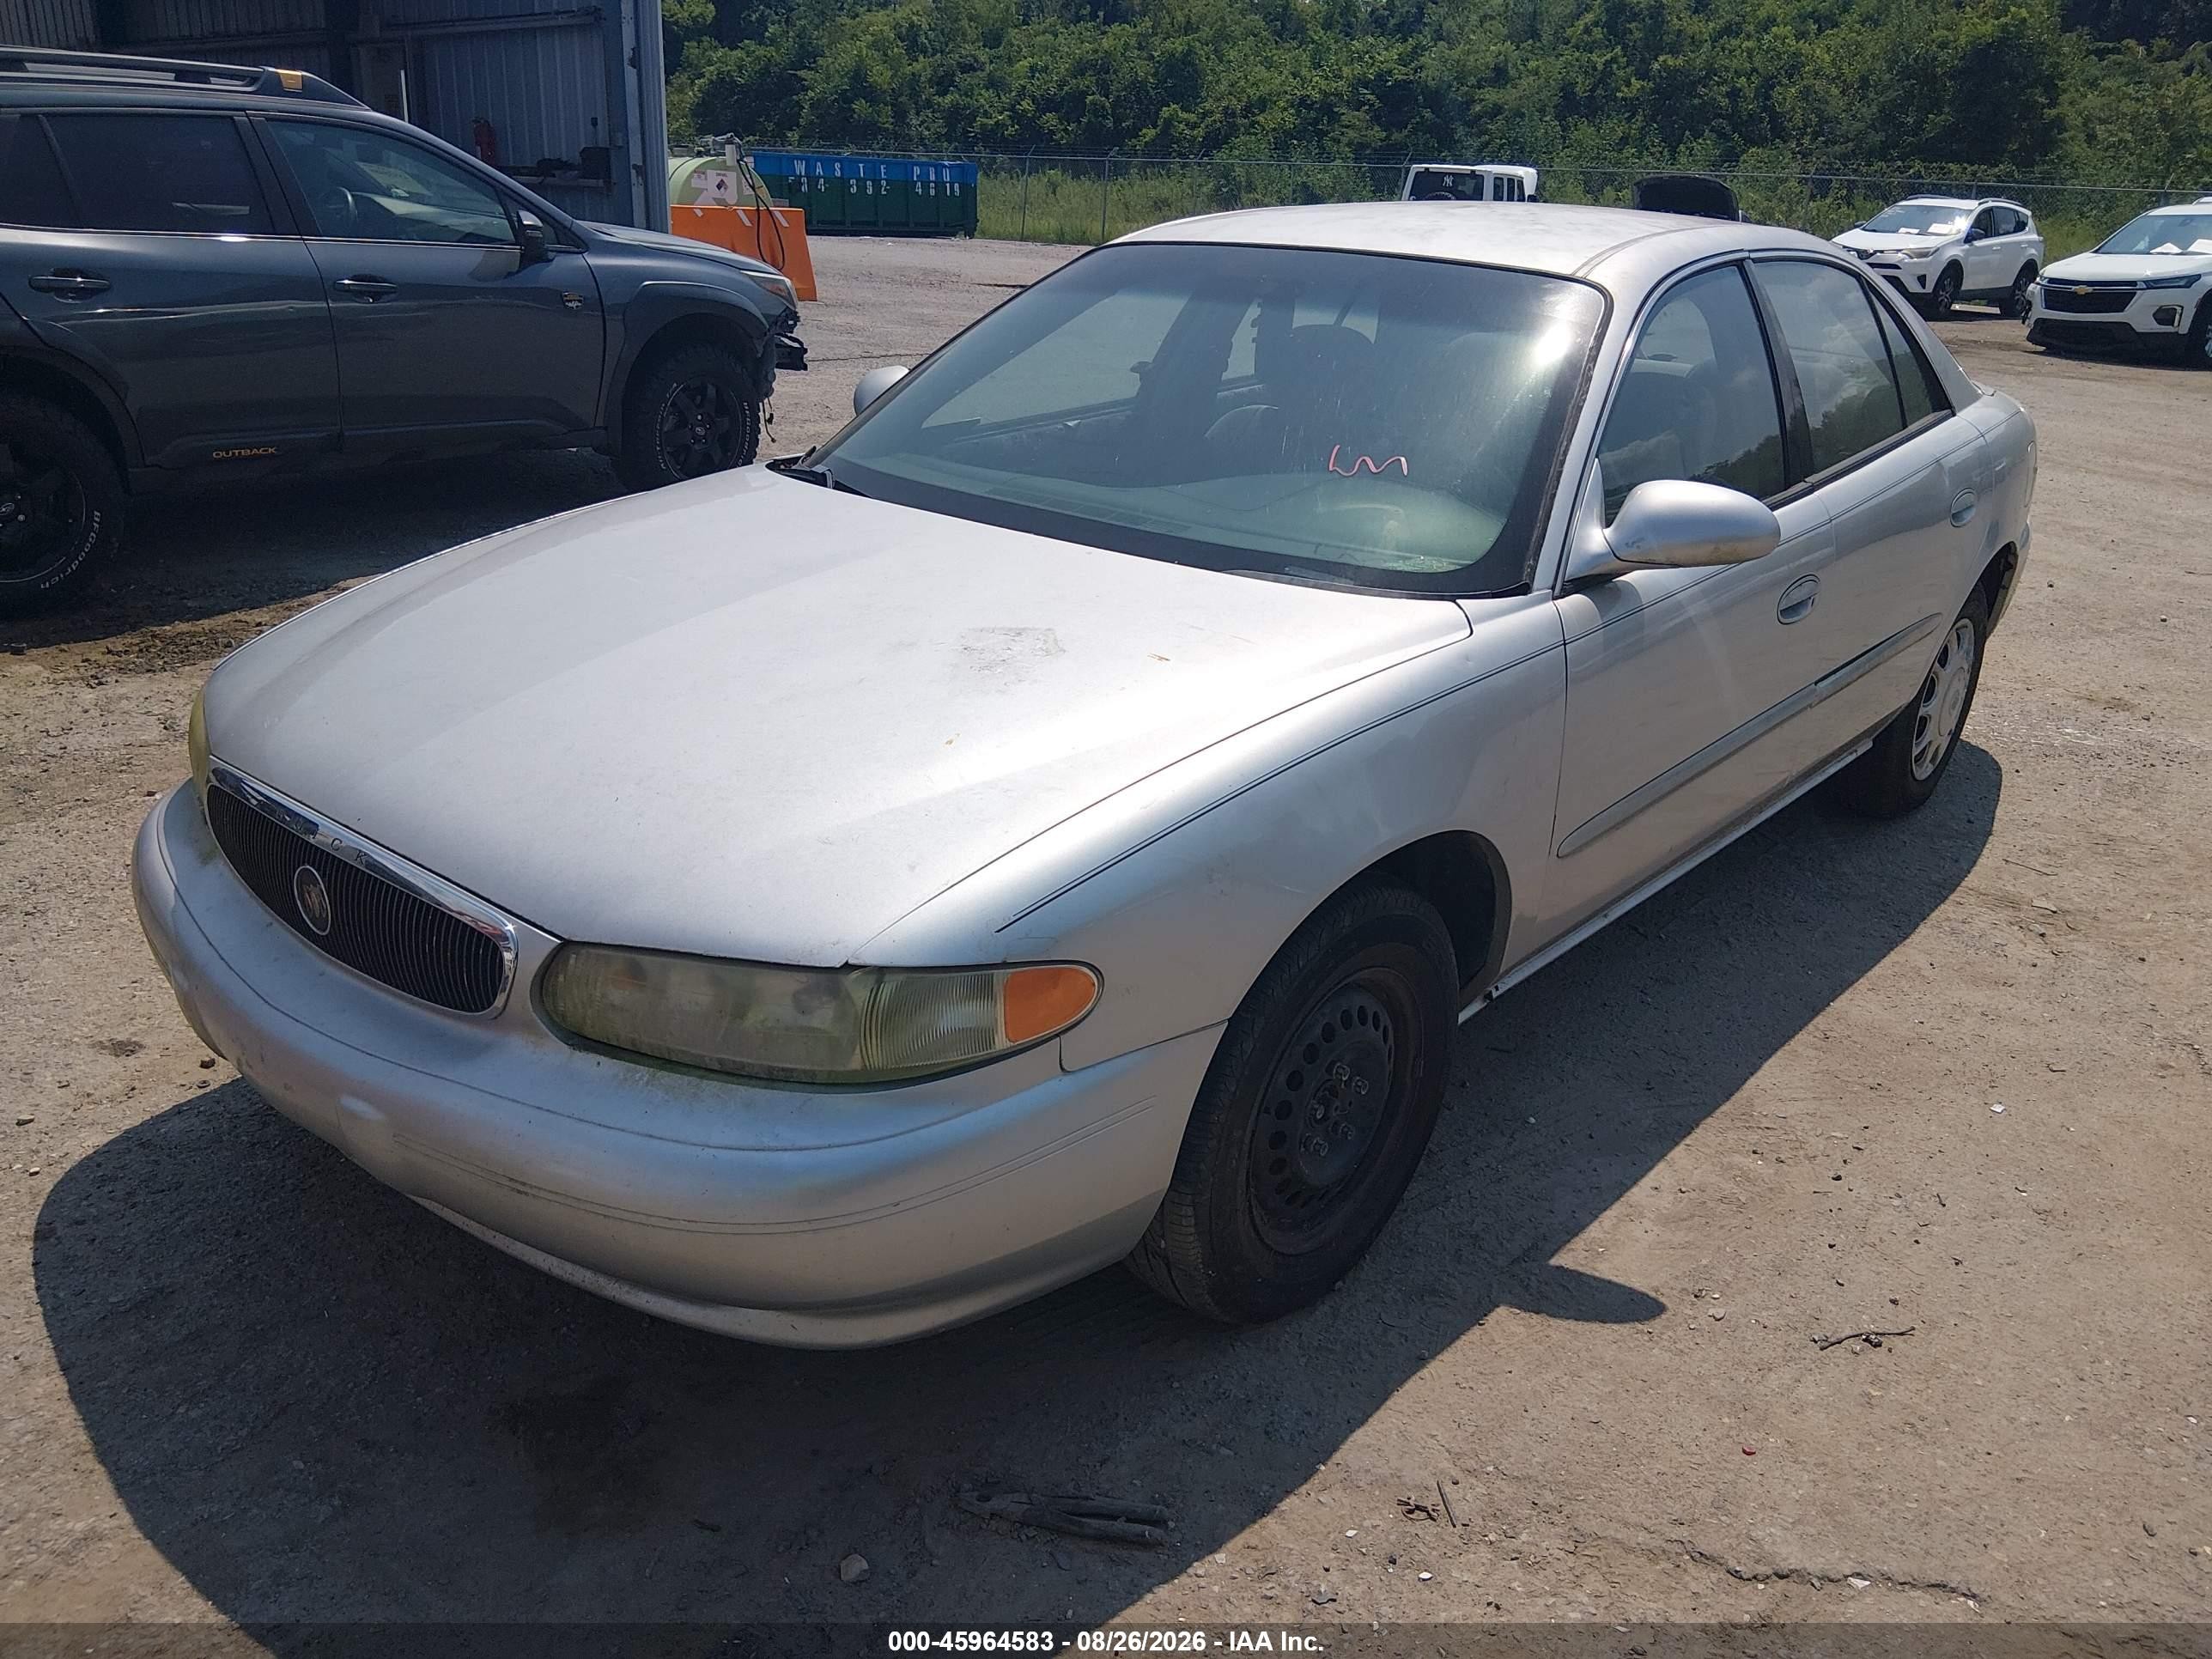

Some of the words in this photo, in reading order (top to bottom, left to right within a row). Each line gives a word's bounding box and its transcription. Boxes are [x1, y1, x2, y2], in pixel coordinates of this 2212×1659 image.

[794, 160, 887, 179] WASTE
[212, 447, 276, 459] OUTBACK
[40, 510, 101, 589] BFGoodrich
